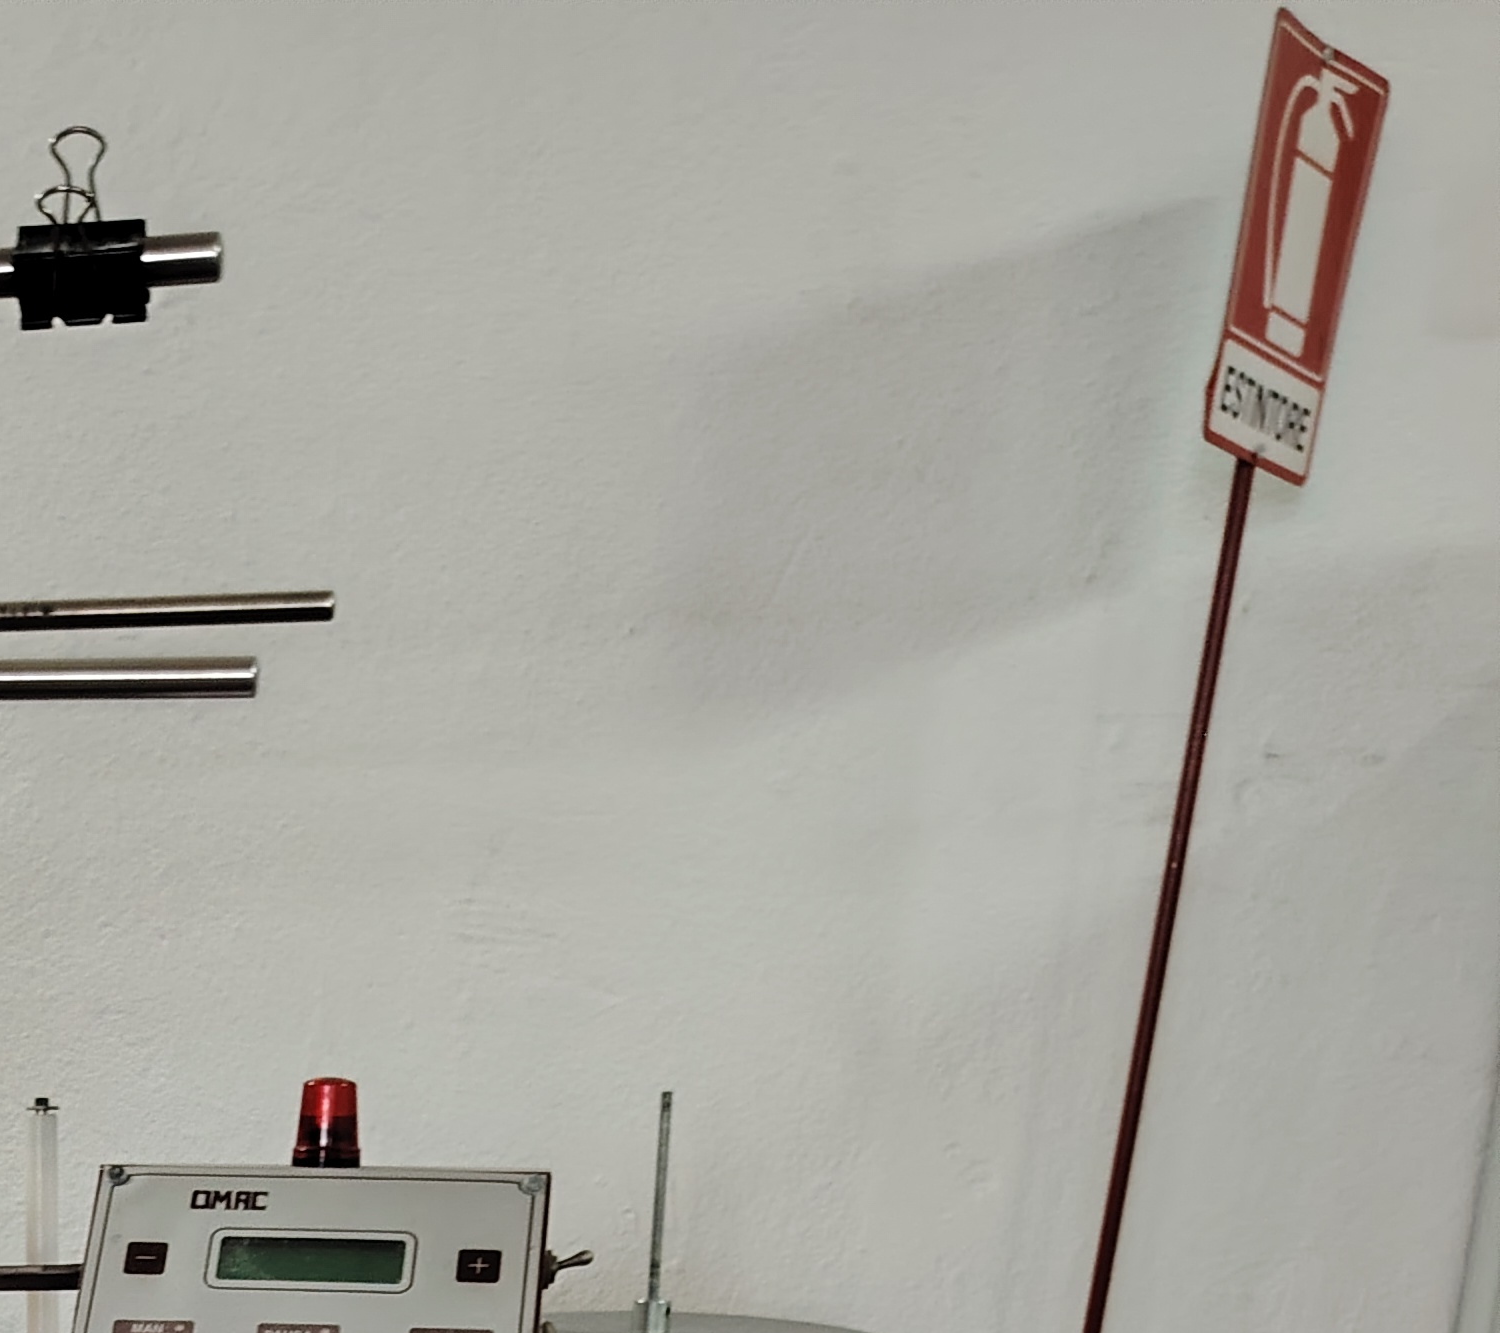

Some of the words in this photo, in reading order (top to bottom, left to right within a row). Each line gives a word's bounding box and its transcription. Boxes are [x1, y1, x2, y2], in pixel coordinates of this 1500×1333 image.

[1219, 364, 1312, 454] ESTINTORE
[190, 1189, 270, 1212] OMAC
[130, 1322, 165, 1333] MAN
